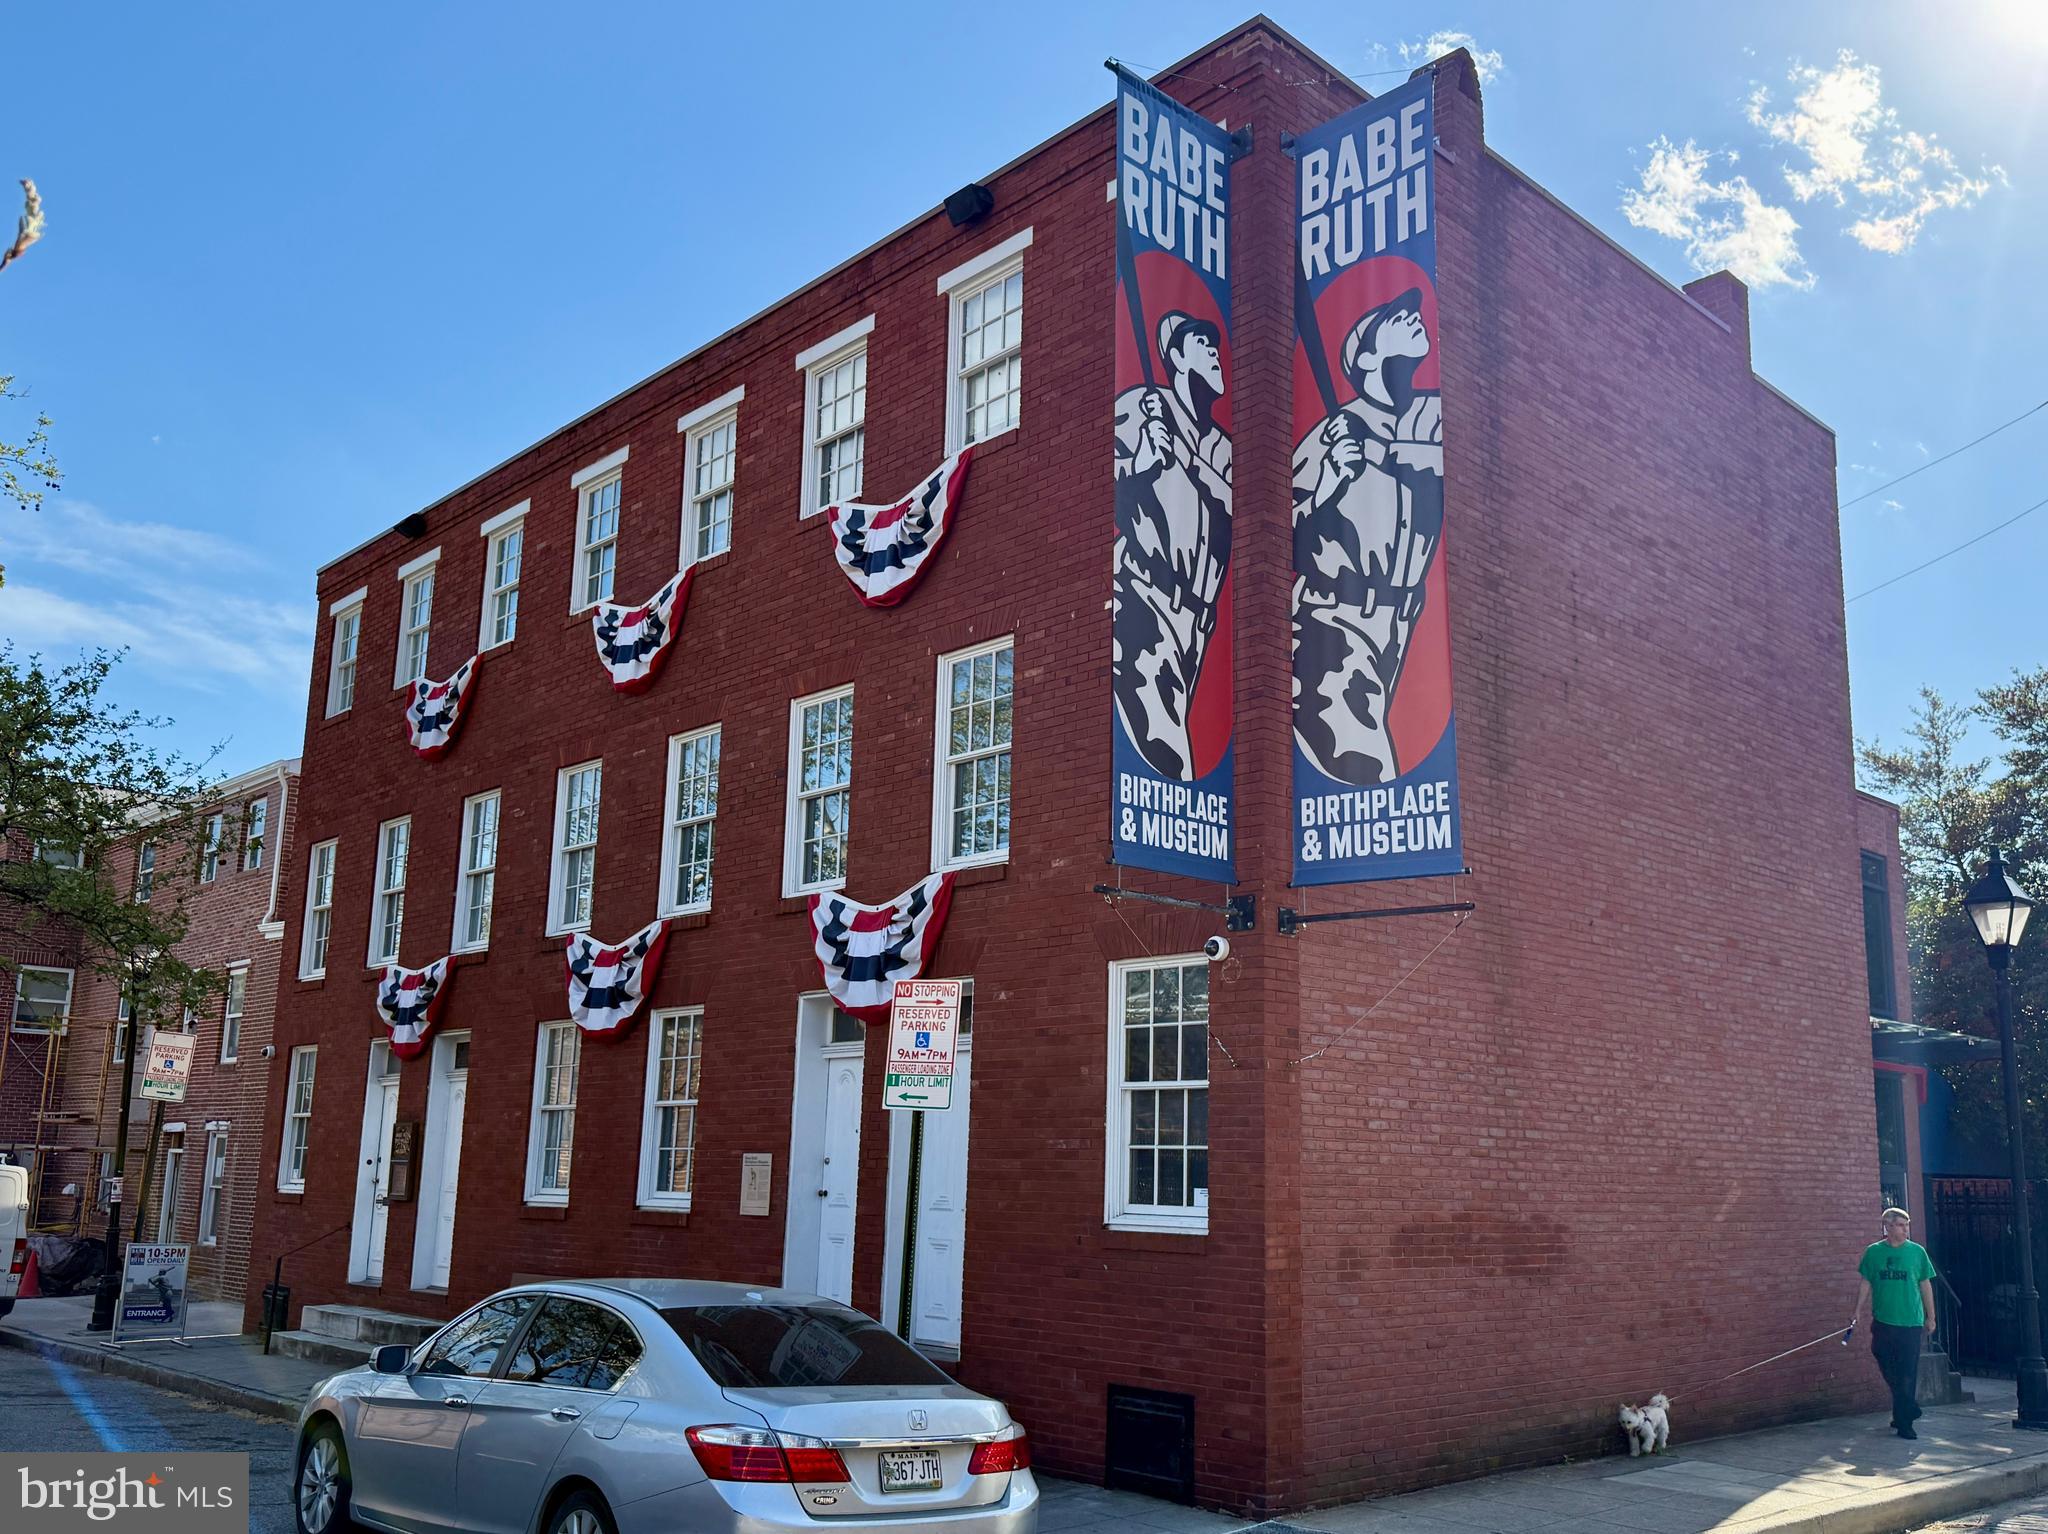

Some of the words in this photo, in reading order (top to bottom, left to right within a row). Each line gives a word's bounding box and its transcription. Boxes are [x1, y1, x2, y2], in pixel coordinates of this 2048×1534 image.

[1124, 91, 1226, 214] BABE
[1302, 98, 1426, 217] BABE
[1123, 160, 1226, 280] RUTH
[1301, 165, 1428, 281] RUTH
[1120, 772, 1228, 826] BIRTHPLACE
[1301, 781, 1451, 827] BIRTHPLACE
[1120, 807, 1137, 843] &
[1142, 813, 1228, 861] MUSEUM
[1301, 830, 1323, 862] &
[1329, 814, 1452, 860] MUSEUM
[897, 984, 912, 996] NO
[914, 985, 956, 997] STOPPING
[898, 1008, 951, 1020] RESERVED
[901, 1020, 946, 1031] PARKING
[154, 1046, 188, 1055] RESERVED
[155, 1052, 185, 1061] PARKING
[897, 1048, 948, 1060] 9AM-7PM
[891, 1063, 917, 1074] PASSENGER
[900, 1076, 925, 1087] HOUR
[928, 1077, 950, 1088] LIMIT
[126, 1309, 167, 1317] ENTRANCE
